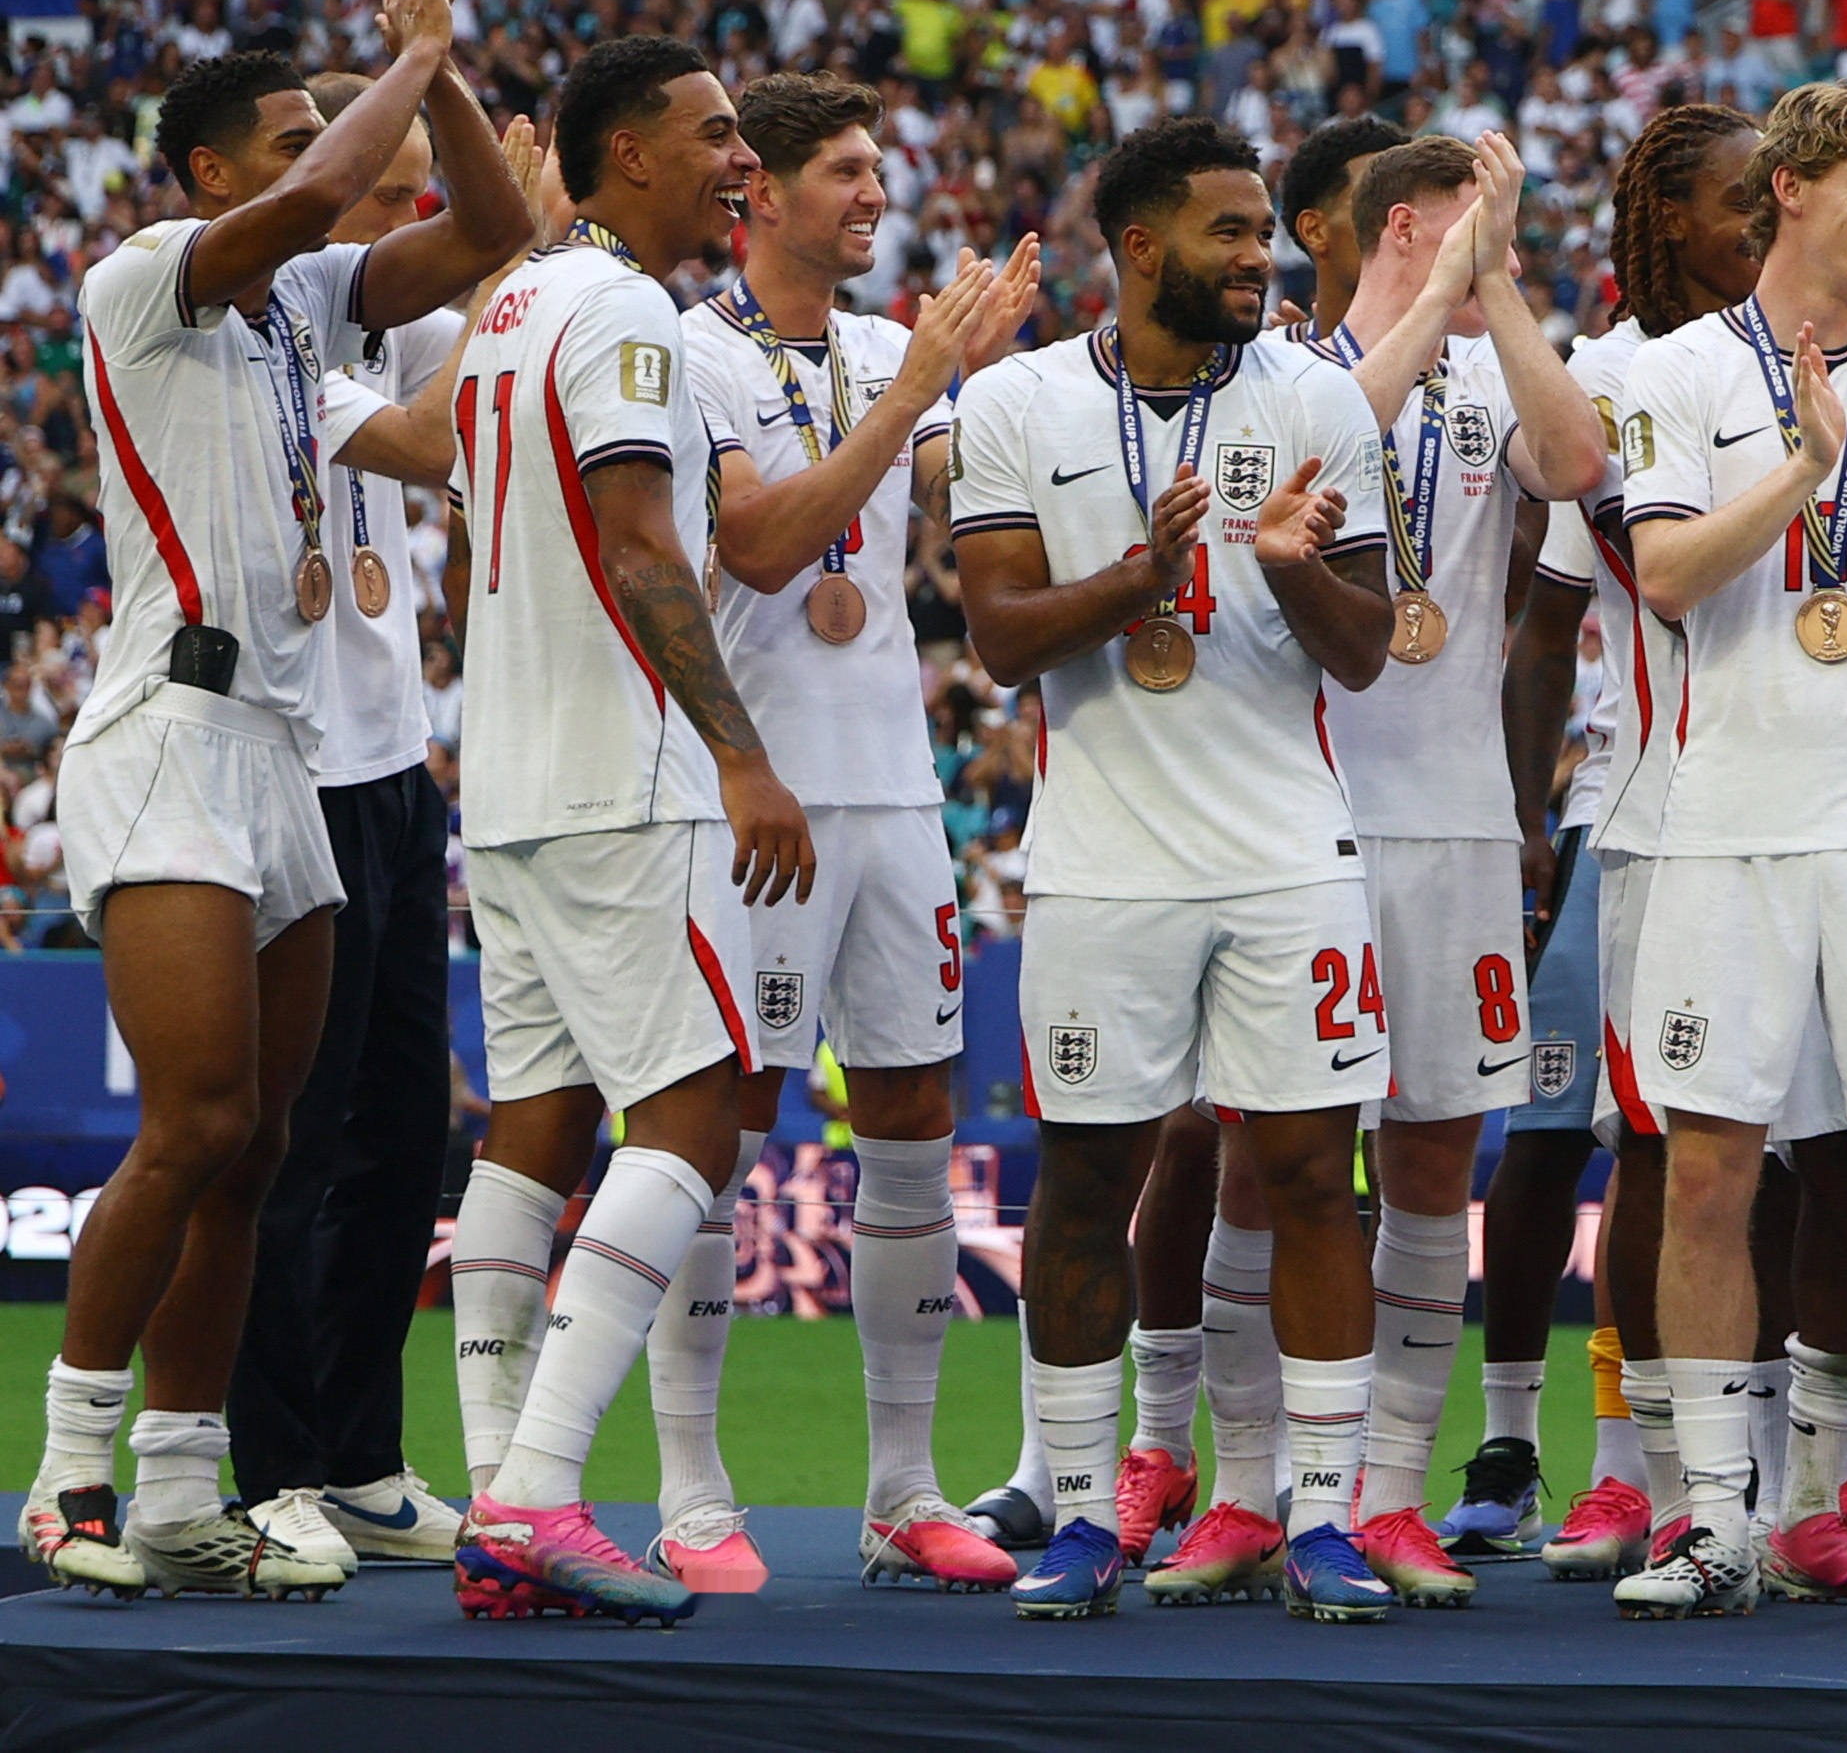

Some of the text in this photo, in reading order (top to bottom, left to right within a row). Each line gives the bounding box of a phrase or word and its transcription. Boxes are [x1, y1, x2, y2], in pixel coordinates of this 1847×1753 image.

[283, 338, 295, 366] CUP
[1757, 329, 1772, 355] CUP
[1766, 354, 1786, 396] 2026
[287, 366, 303, 413] WORLD
[1124, 415, 1138, 438] CUP
[1186, 397, 1205, 464] FIFA WORL
[1127, 440, 1141, 485] 2026
[1424, 437, 1436, 480] 2026
[456, 371, 516, 594] 11
[1420, 481, 1431, 506] CUP
[1460, 472, 1496, 484] FRANCE
[355, 513, 368, 544] ORLD
[1222, 517, 1258, 531] FRANC
[1413, 507, 1428, 554] WORLD
[934, 901, 961, 993] 5
[1311, 942, 1386, 1042] 24
[1473, 953, 1521, 1045] 8
[548, 1314, 572, 1331] NG
[688, 1300, 729, 1317] ENG
[459, 1339, 505, 1359] ENG
[1057, 1474, 1092, 1493] ENG
[1301, 1472, 1342, 1489] ENG
